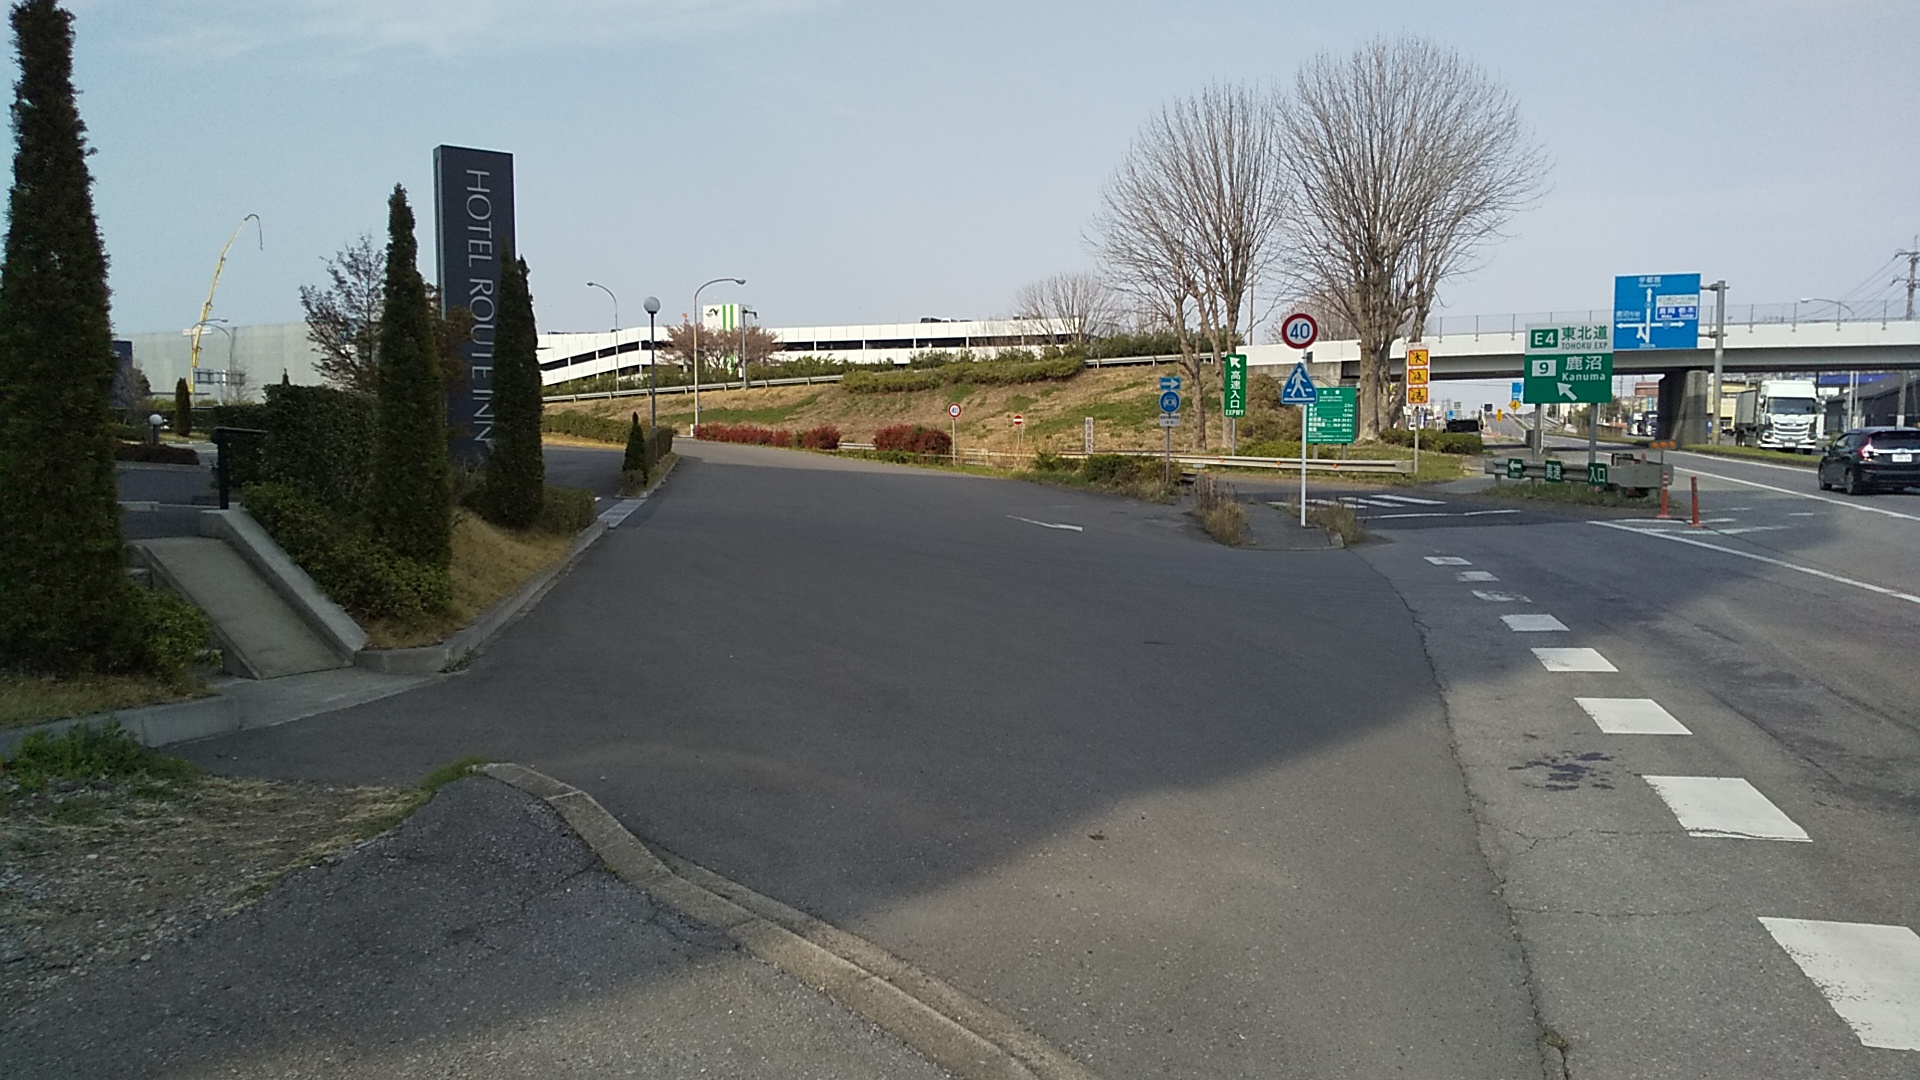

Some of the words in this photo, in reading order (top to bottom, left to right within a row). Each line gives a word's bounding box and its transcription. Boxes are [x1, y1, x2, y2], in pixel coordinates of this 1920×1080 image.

[466, 169, 492, 268] HOTEL
[1290, 322, 1310, 339] 40
[1561, 325, 1608, 341] 東北道
[1534, 332, 1555, 346] E4
[1561, 341, 1592, 350] TOHOKU
[1594, 341, 1608, 350] EXP
[1539, 362, 1549, 374] 9
[1565, 355, 1602, 371] 鹿沼
[1562, 372, 1606, 381] Kanuma
[1230, 370, 1241, 409] 高速入口
[472, 389, 495, 441] INN
[951, 406, 959, 414] 40
[1545, 463, 1561, 480] 高速
[1588, 466, 1606, 483] 入口
